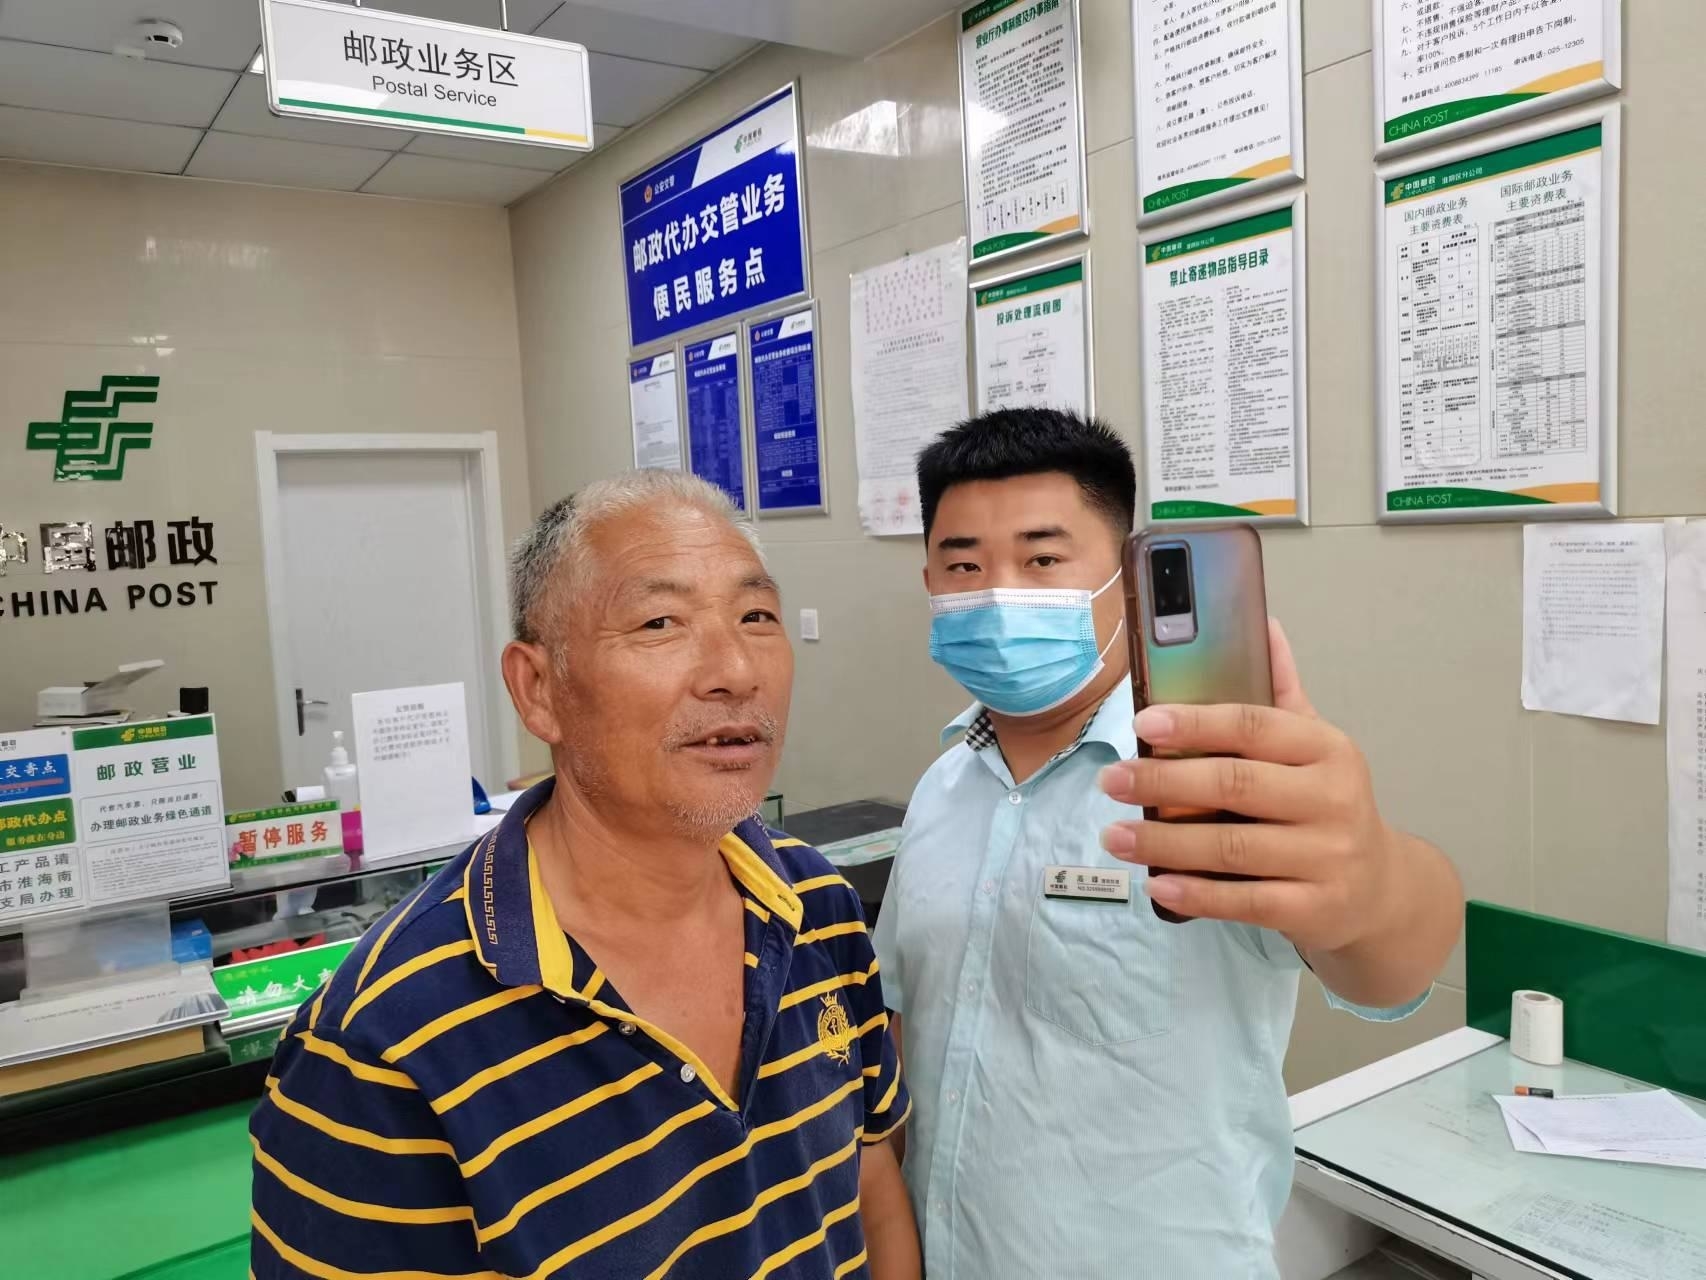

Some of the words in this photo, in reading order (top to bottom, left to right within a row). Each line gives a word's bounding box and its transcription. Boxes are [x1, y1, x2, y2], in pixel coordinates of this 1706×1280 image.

[343, 29, 519, 87] 邮政业务区
[372, 75, 428, 97] Postal
[434, 85, 497, 107] Service
[1389, 120, 1421, 137] CHINA
[1424, 109, 1449, 126] POST
[1500, 169, 1573, 198] 国际邮政业务
[1404, 196, 1468, 222] 国内邮政业务
[1506, 188, 1567, 212] 主要资费表
[633, 172, 785, 273] 邮政代办交管业务
[1409, 213, 1463, 235] 主要资费表
[1170, 248, 1269, 287] 禁止寄递物品指导目录
[653, 247, 766, 321] 便民服务点
[997, 299, 1062, 326] 投诉处理流程图
[1393, 496, 1424, 508] CHINA
[1427, 493, 1452, 505] POST
[0, 586, 107, 617] HINA
[127, 581, 218, 609] POST
[0, 760, 57, 780] 交寄点
[97, 754, 196, 780] 邮政营业
[90, 805, 212, 832] 办理邮政业务绿色通道
[239, 820, 328, 854] 暂停服务
